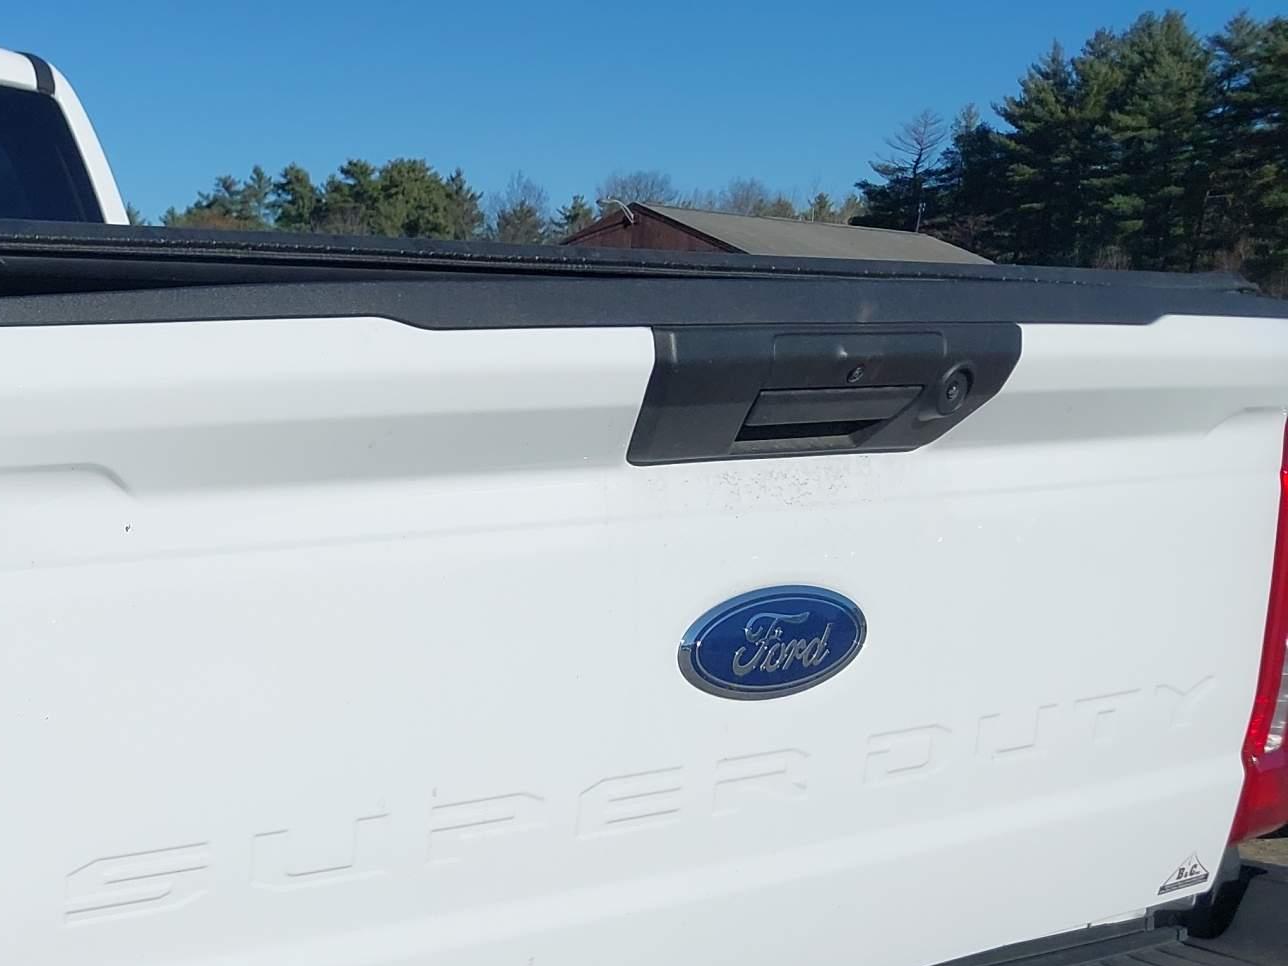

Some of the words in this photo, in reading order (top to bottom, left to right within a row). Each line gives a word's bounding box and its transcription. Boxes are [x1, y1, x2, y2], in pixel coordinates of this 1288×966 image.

[732, 611, 834, 676] Ford
[61, 744, 812, 927] SUPER
[862, 673, 1217, 789] DUTY
